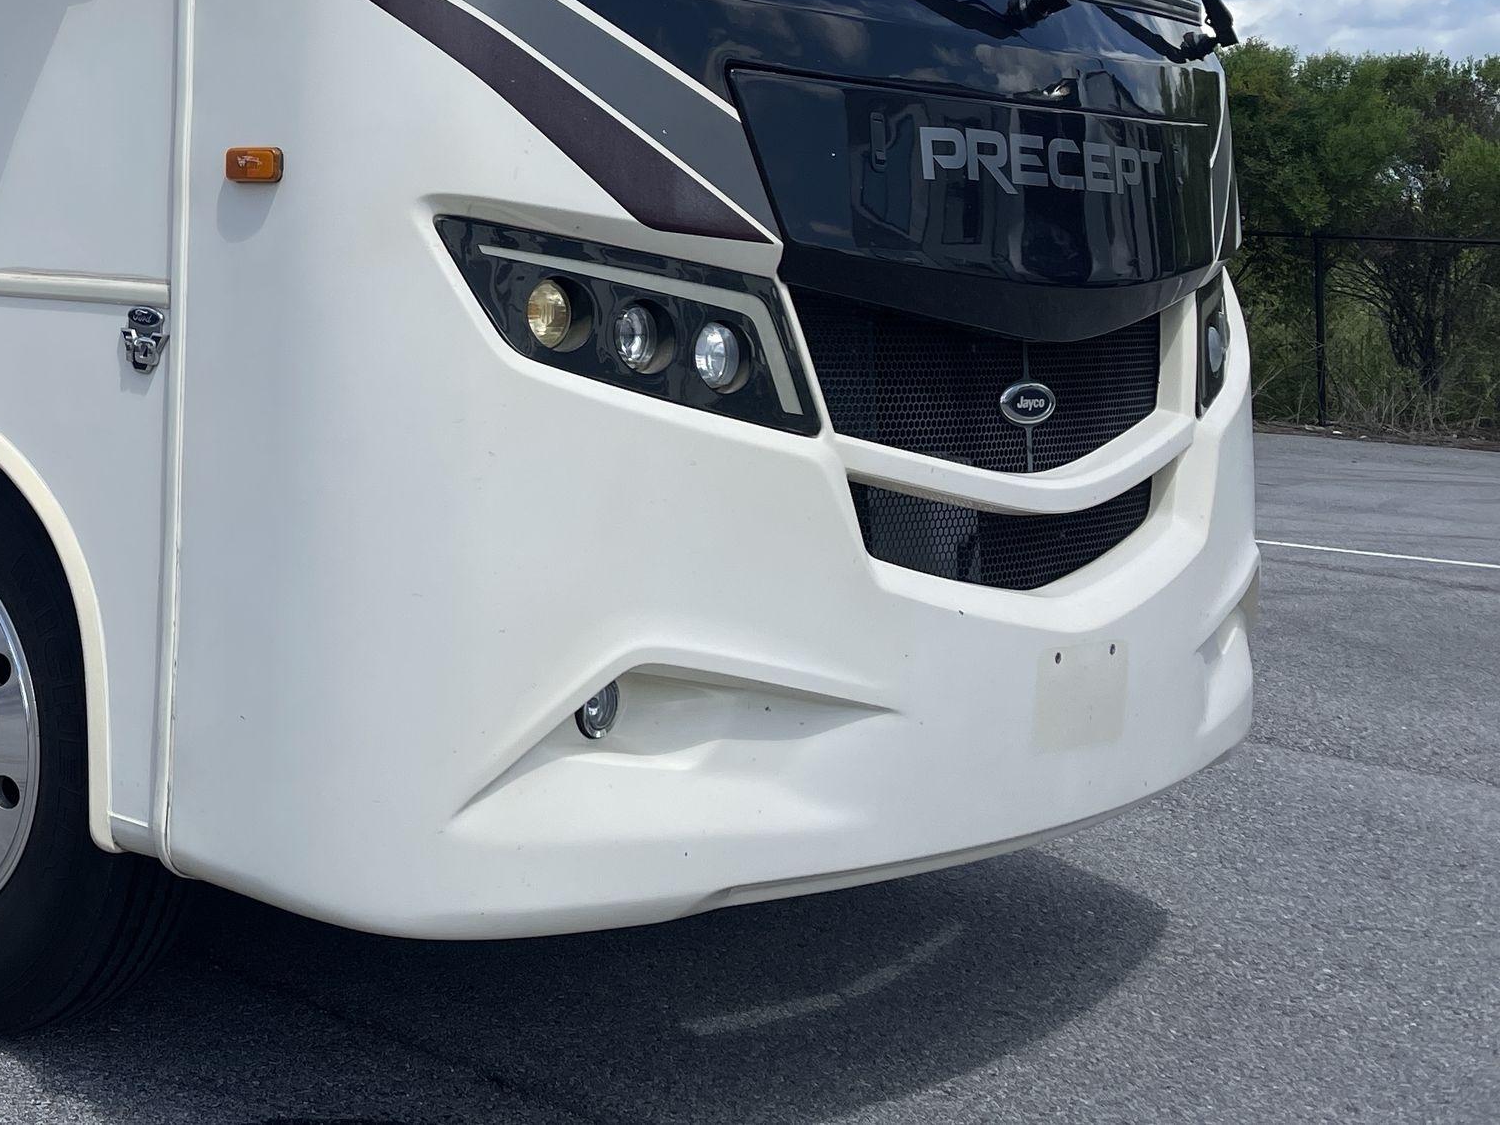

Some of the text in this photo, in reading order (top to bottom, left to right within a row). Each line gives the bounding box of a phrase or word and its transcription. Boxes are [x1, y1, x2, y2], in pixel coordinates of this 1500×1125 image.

[919, 126, 1162, 198] PRECEPT
[132, 309, 153, 324] Ford
[1016, 395, 1045, 412] Jayco
